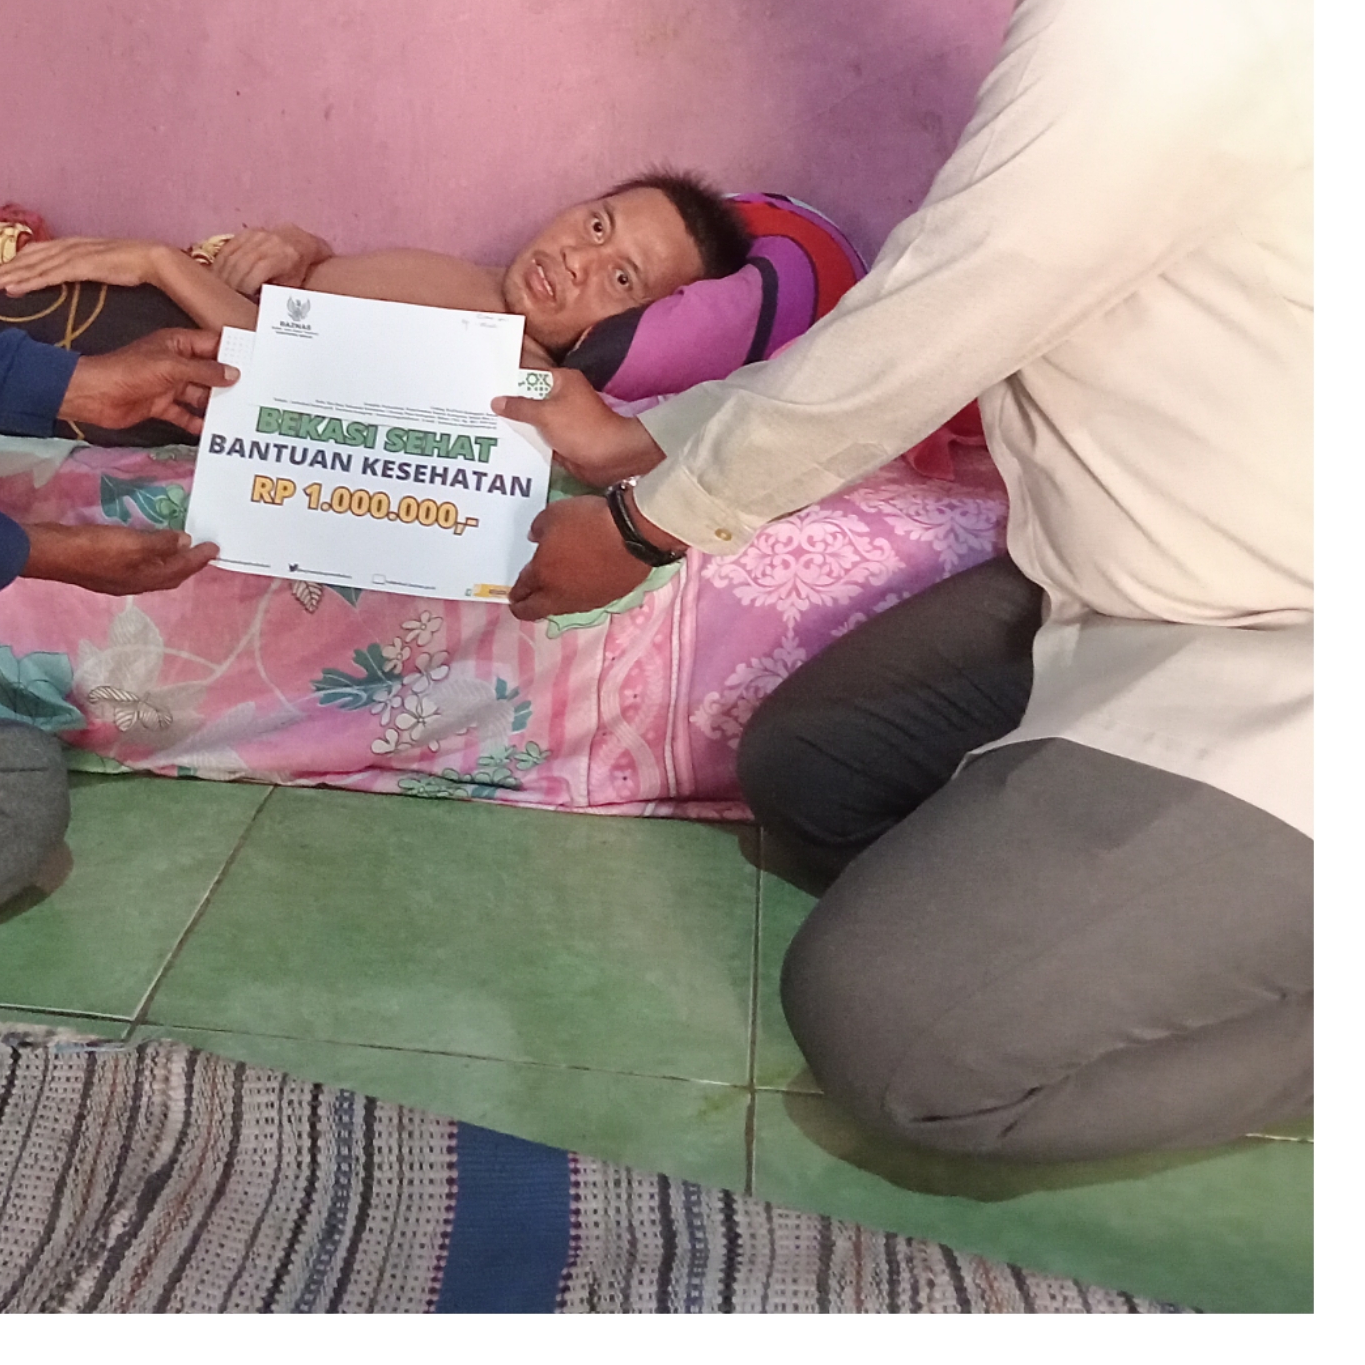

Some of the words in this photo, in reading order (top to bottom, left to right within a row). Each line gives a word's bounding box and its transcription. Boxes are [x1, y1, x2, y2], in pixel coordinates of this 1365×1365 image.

[208, 433, 353, 472] BANTUAN
[361, 457, 533, 499] KESEHATAN
[255, 406, 378, 450] BEKASI
[383, 426, 498, 464] SEHAT
[250, 474, 296, 506] RP
[303, 481, 479, 536] 1.000.000,-
